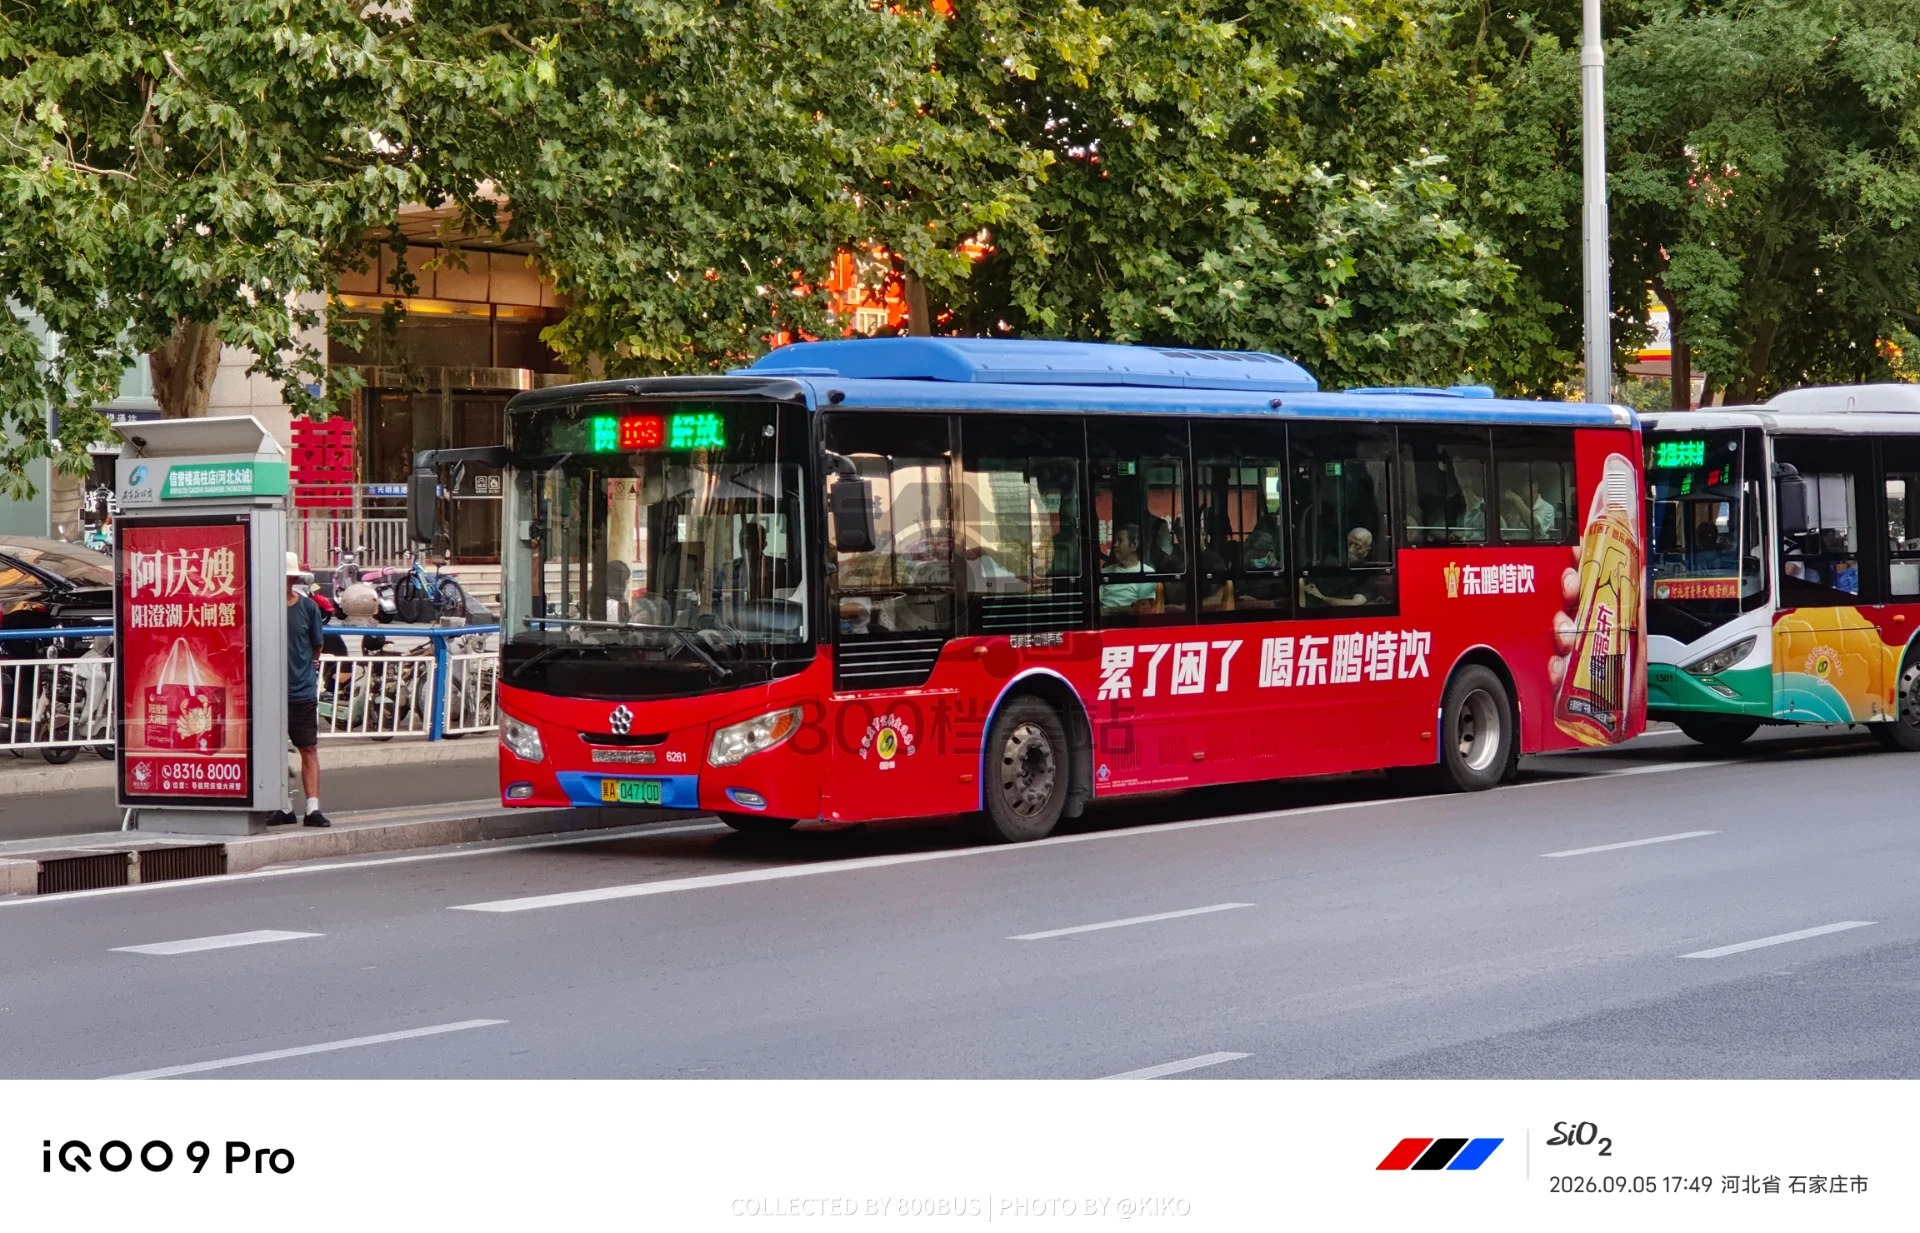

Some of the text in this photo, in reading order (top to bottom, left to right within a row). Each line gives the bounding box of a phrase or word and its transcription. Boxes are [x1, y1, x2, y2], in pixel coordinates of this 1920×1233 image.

[131, 547, 236, 598] 阿庆嫂
[1462, 563, 1536, 596] 东鹏特饮
[131, 603, 236, 628] 阳澄湖大闸蟹
[1097, 629, 1432, 700] 累了困了 喝东鹏特饮
[173, 763, 241, 780] 8316 8000
[666, 751, 687, 763] 6261
